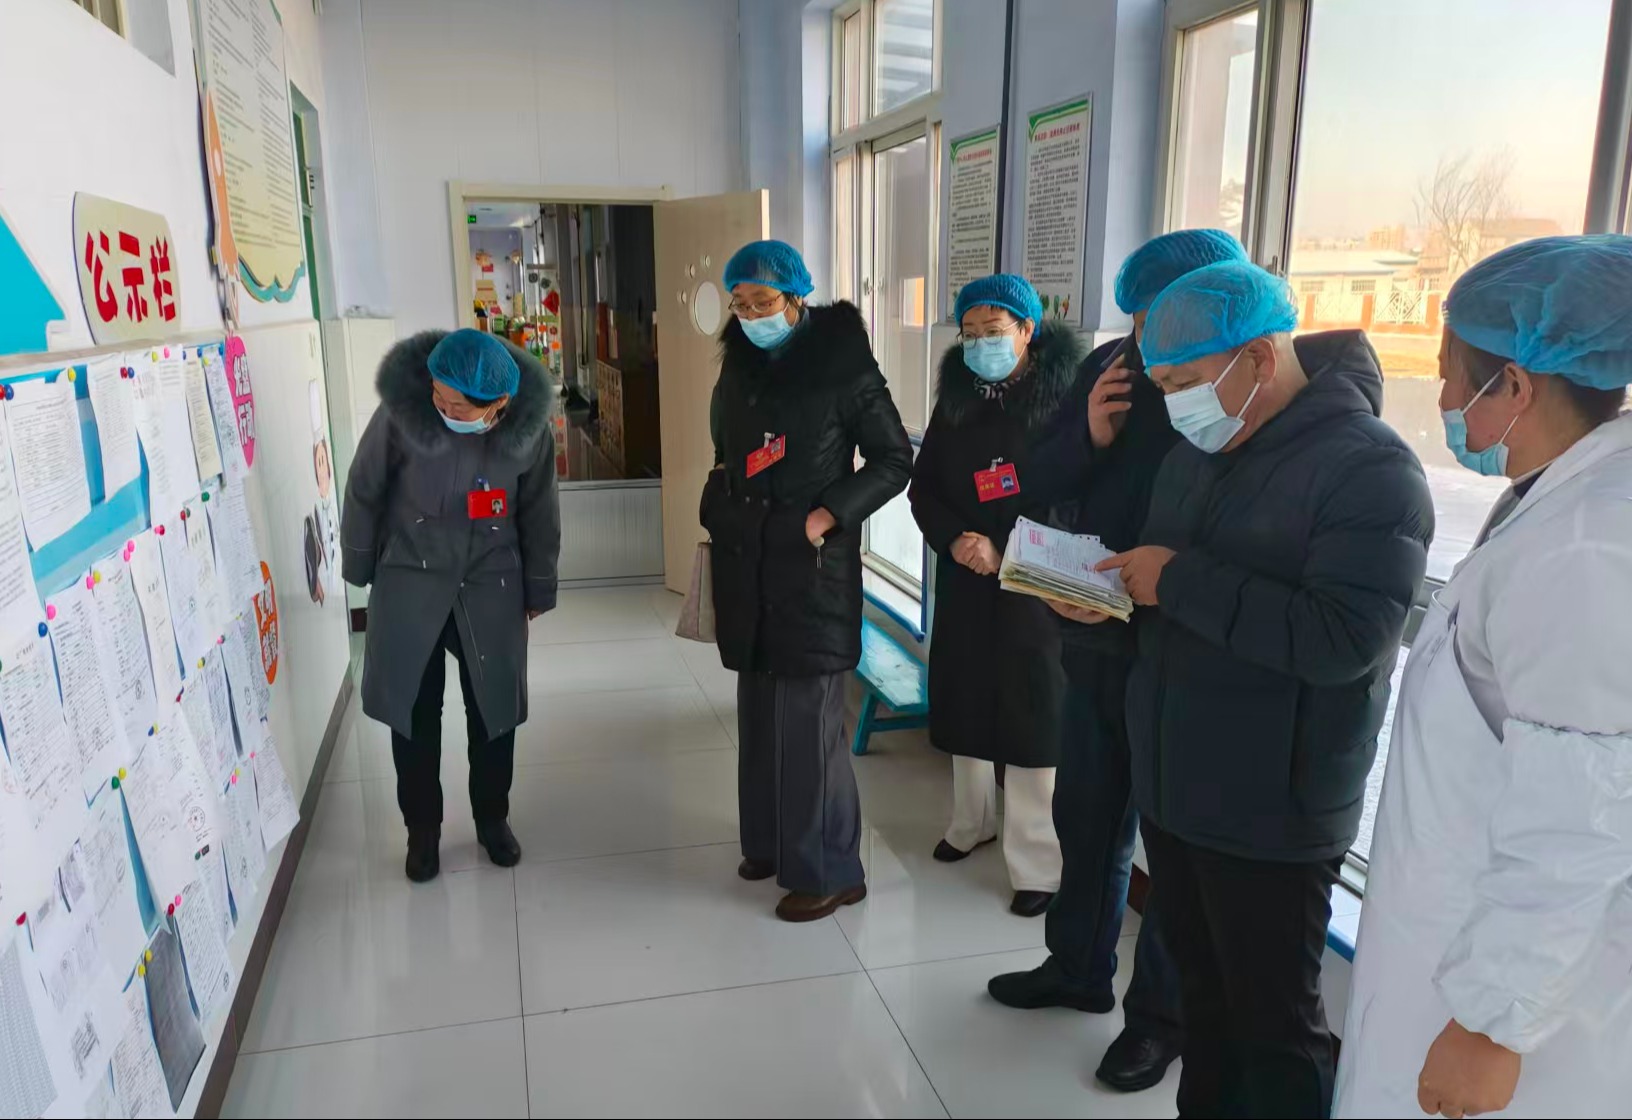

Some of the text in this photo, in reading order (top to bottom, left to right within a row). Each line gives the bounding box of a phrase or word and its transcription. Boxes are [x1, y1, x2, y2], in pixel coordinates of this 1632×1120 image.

[85, 230, 177, 323] 公示栏
[233, 353, 252, 398] 光盘
